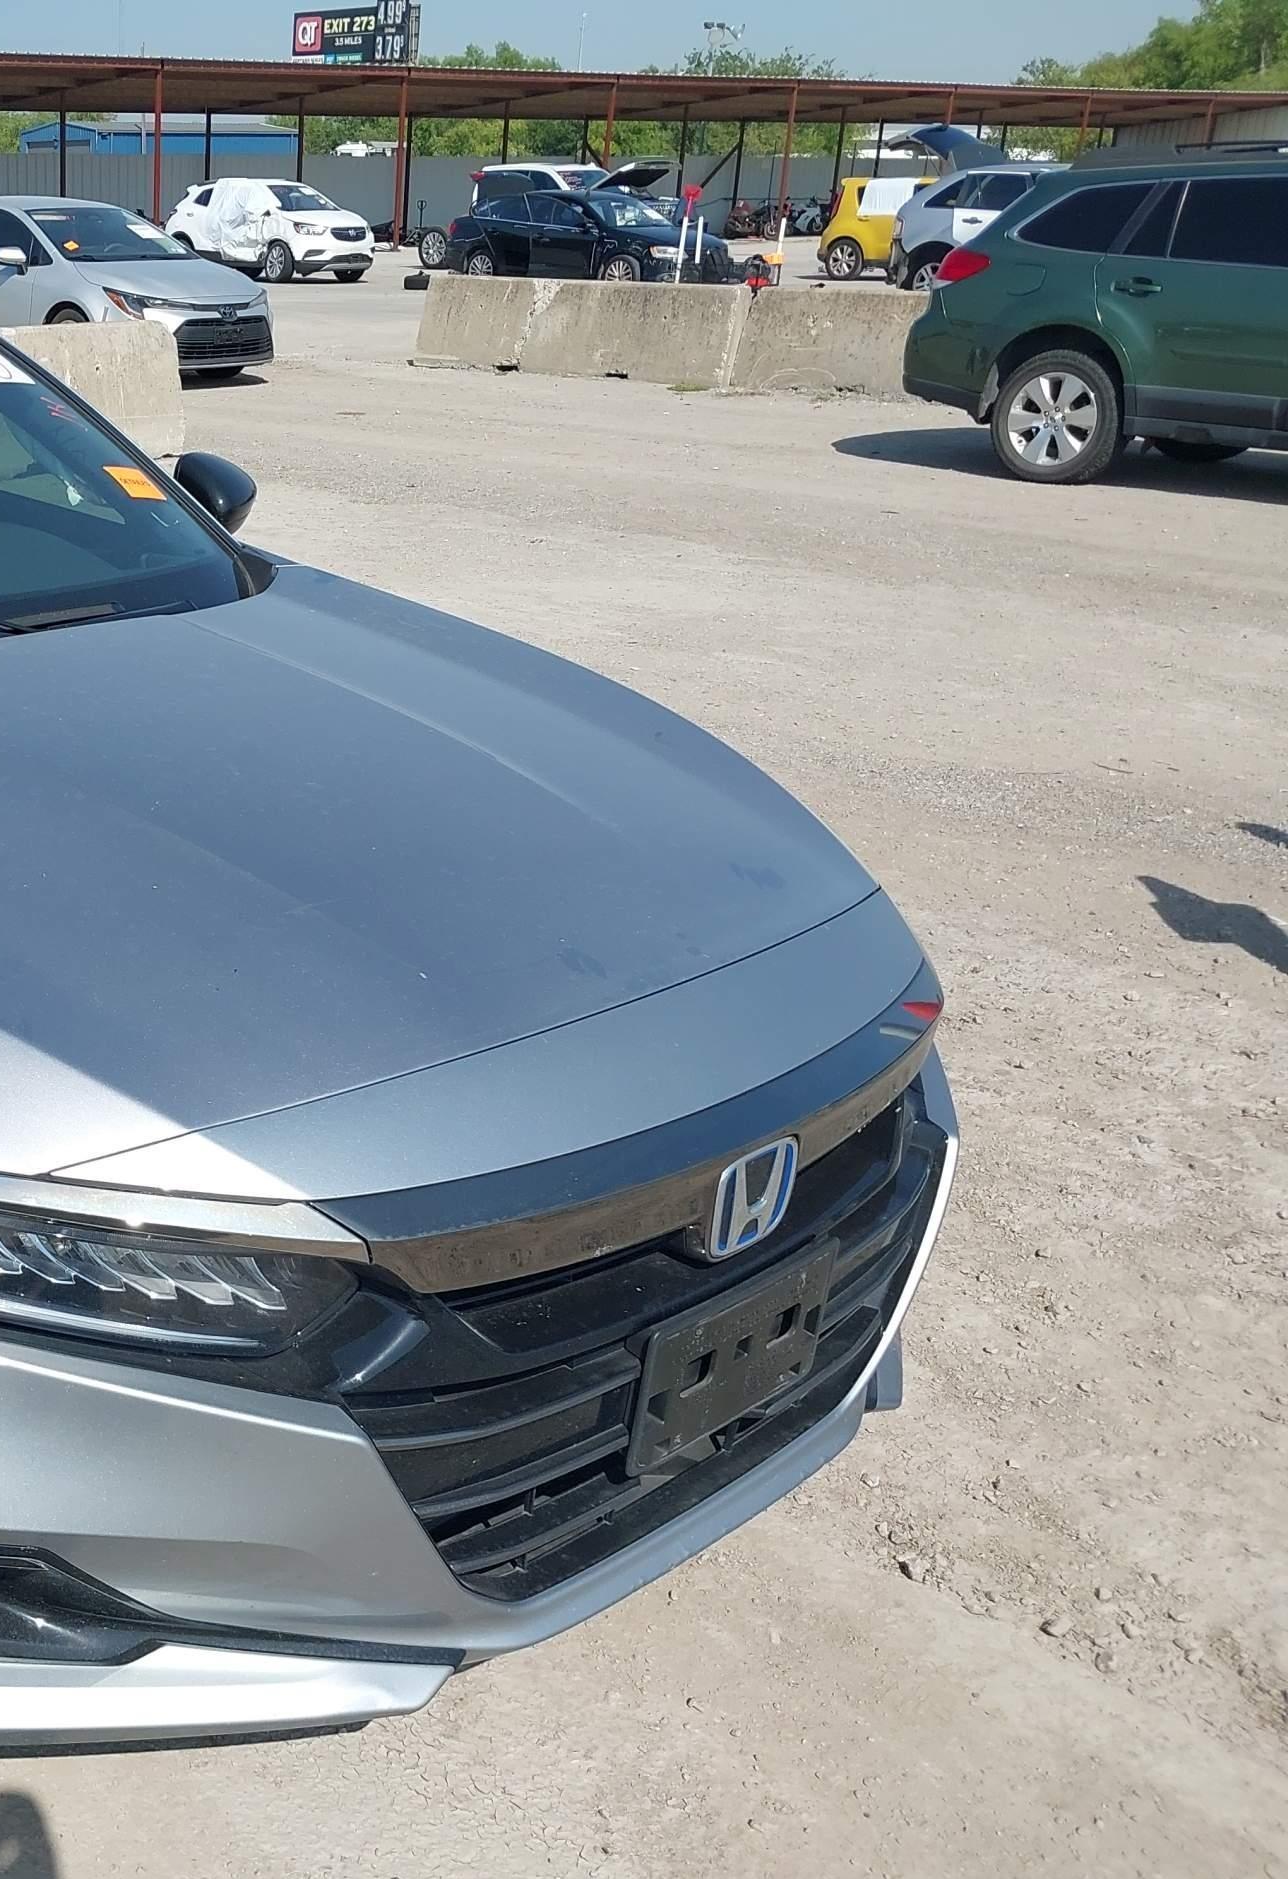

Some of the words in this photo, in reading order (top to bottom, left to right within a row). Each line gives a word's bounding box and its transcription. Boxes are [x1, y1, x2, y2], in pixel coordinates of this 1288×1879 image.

[297, 21, 318, 46] QT
[323, 18, 351, 34] EXIT
[353, 15, 376, 32] 273
